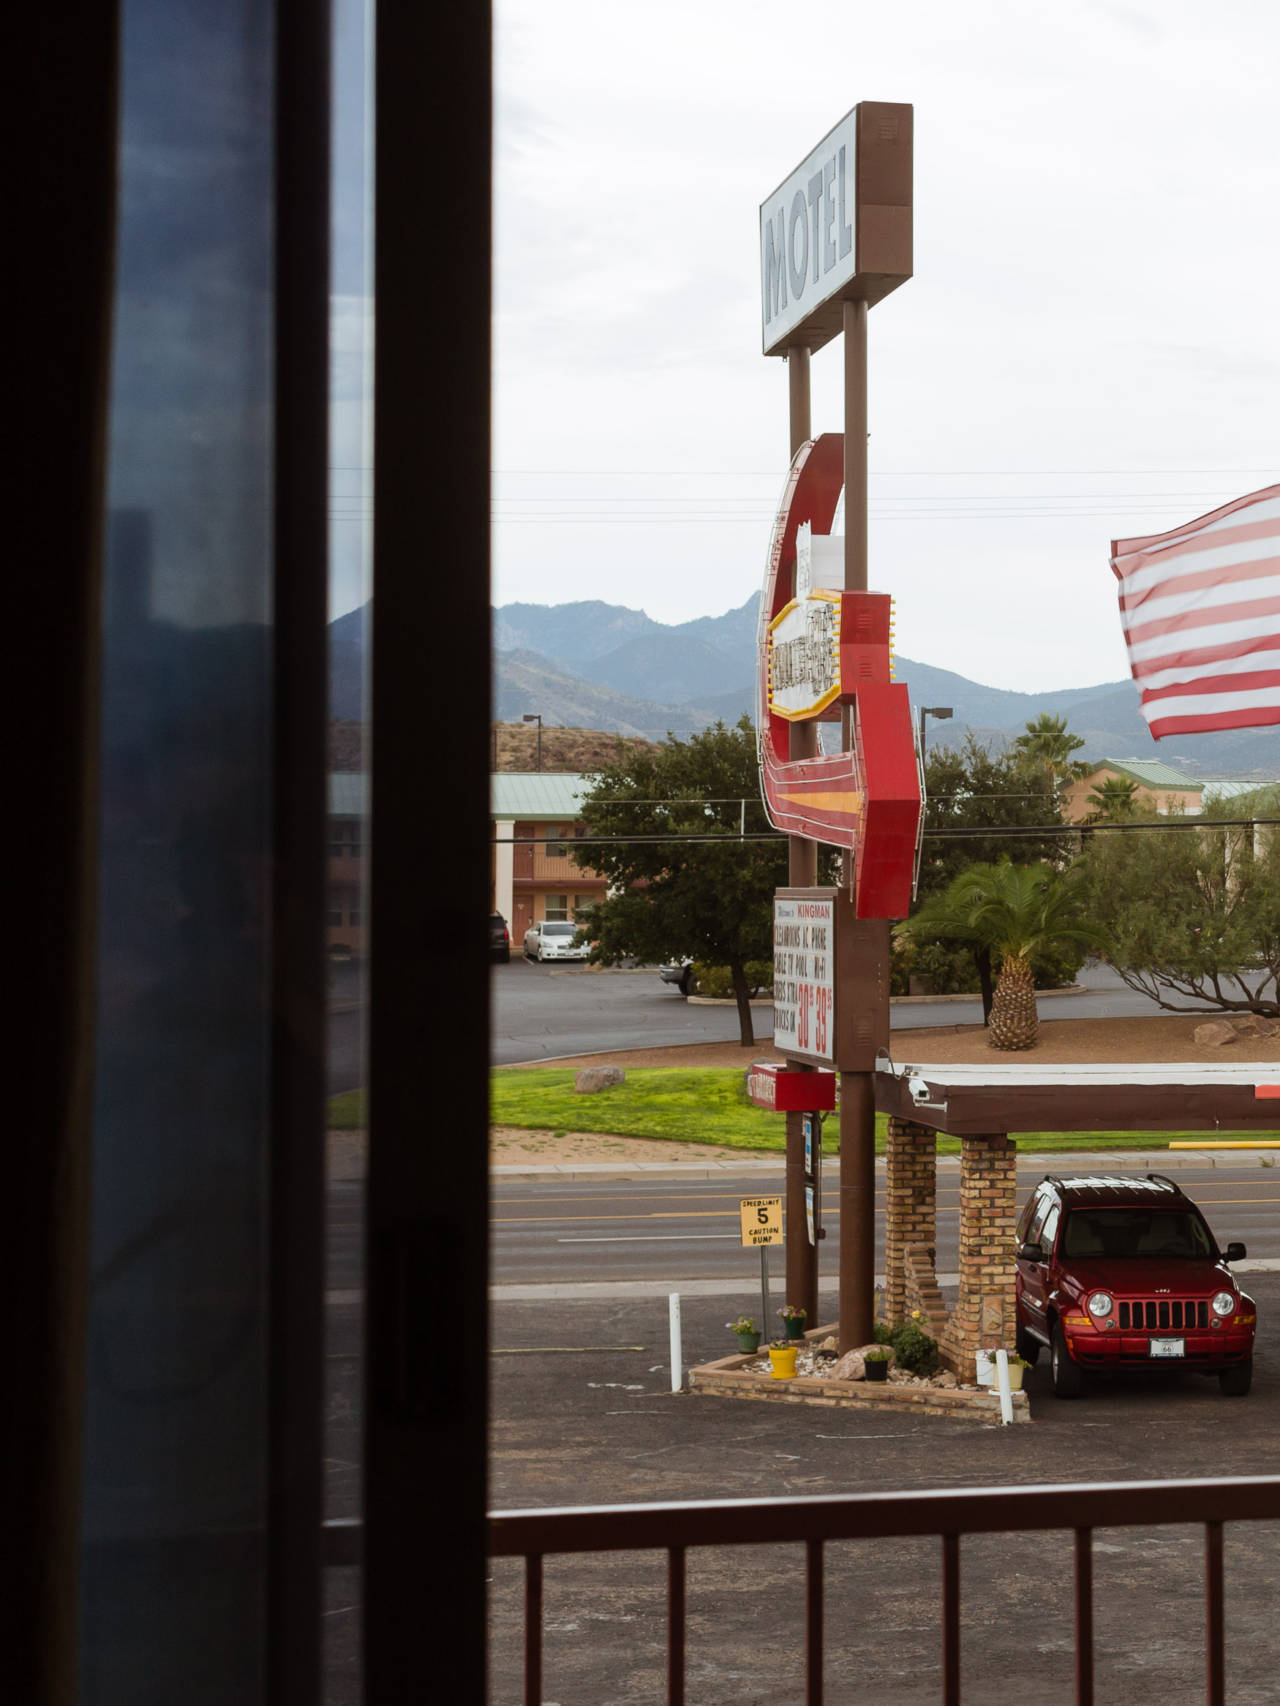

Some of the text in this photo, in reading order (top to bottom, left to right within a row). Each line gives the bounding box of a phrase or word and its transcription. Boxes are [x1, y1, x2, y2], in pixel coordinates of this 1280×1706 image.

[765, 144, 852, 325] MOTEL
[797, 904, 830, 919] KINGMAN
[816, 986, 827, 1054] 39
[757, 1207, 769, 1225] 5
[749, 1227, 779, 1235] CAUTION
[753, 1236, 772, 1244] BUMP
